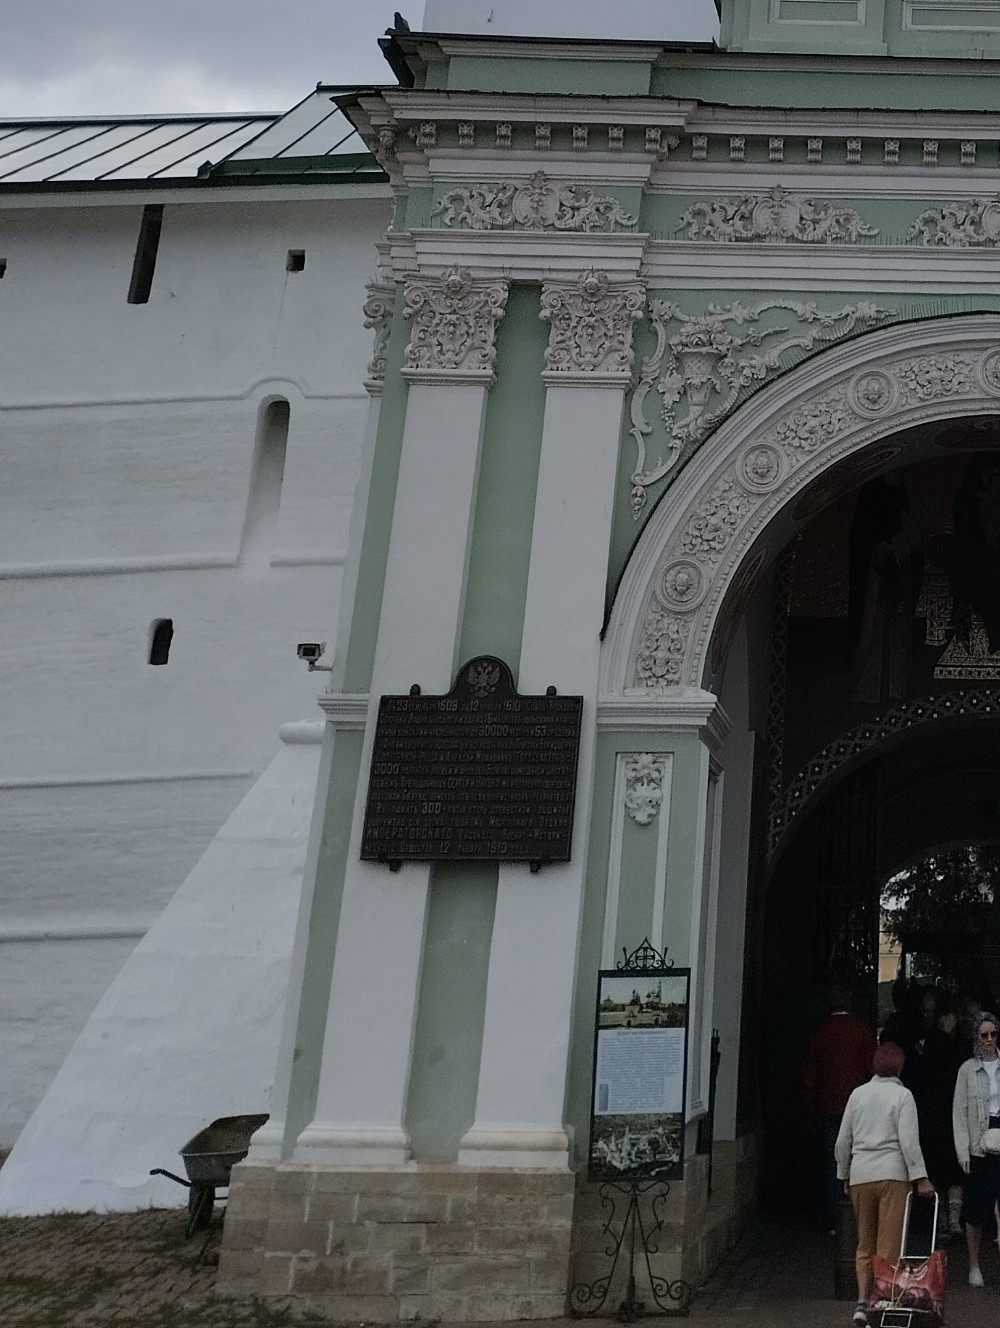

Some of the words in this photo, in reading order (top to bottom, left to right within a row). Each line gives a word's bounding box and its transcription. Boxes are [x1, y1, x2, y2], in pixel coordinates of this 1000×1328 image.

[396, 699, 408, 710] 23
[437, 699, 458, 710] 1608
[469, 700, 479, 710] 12
[484, 712, 493, 723] 16
[478, 725, 508, 736] 30000
[534, 725, 546, 736] 63
[373, 762, 399, 774] 3000
[365, 827, 453, 839] ИМПЕРАТОРСКАГО
[439, 841, 450, 852] 12
[486, 841, 507, 853] 1910
